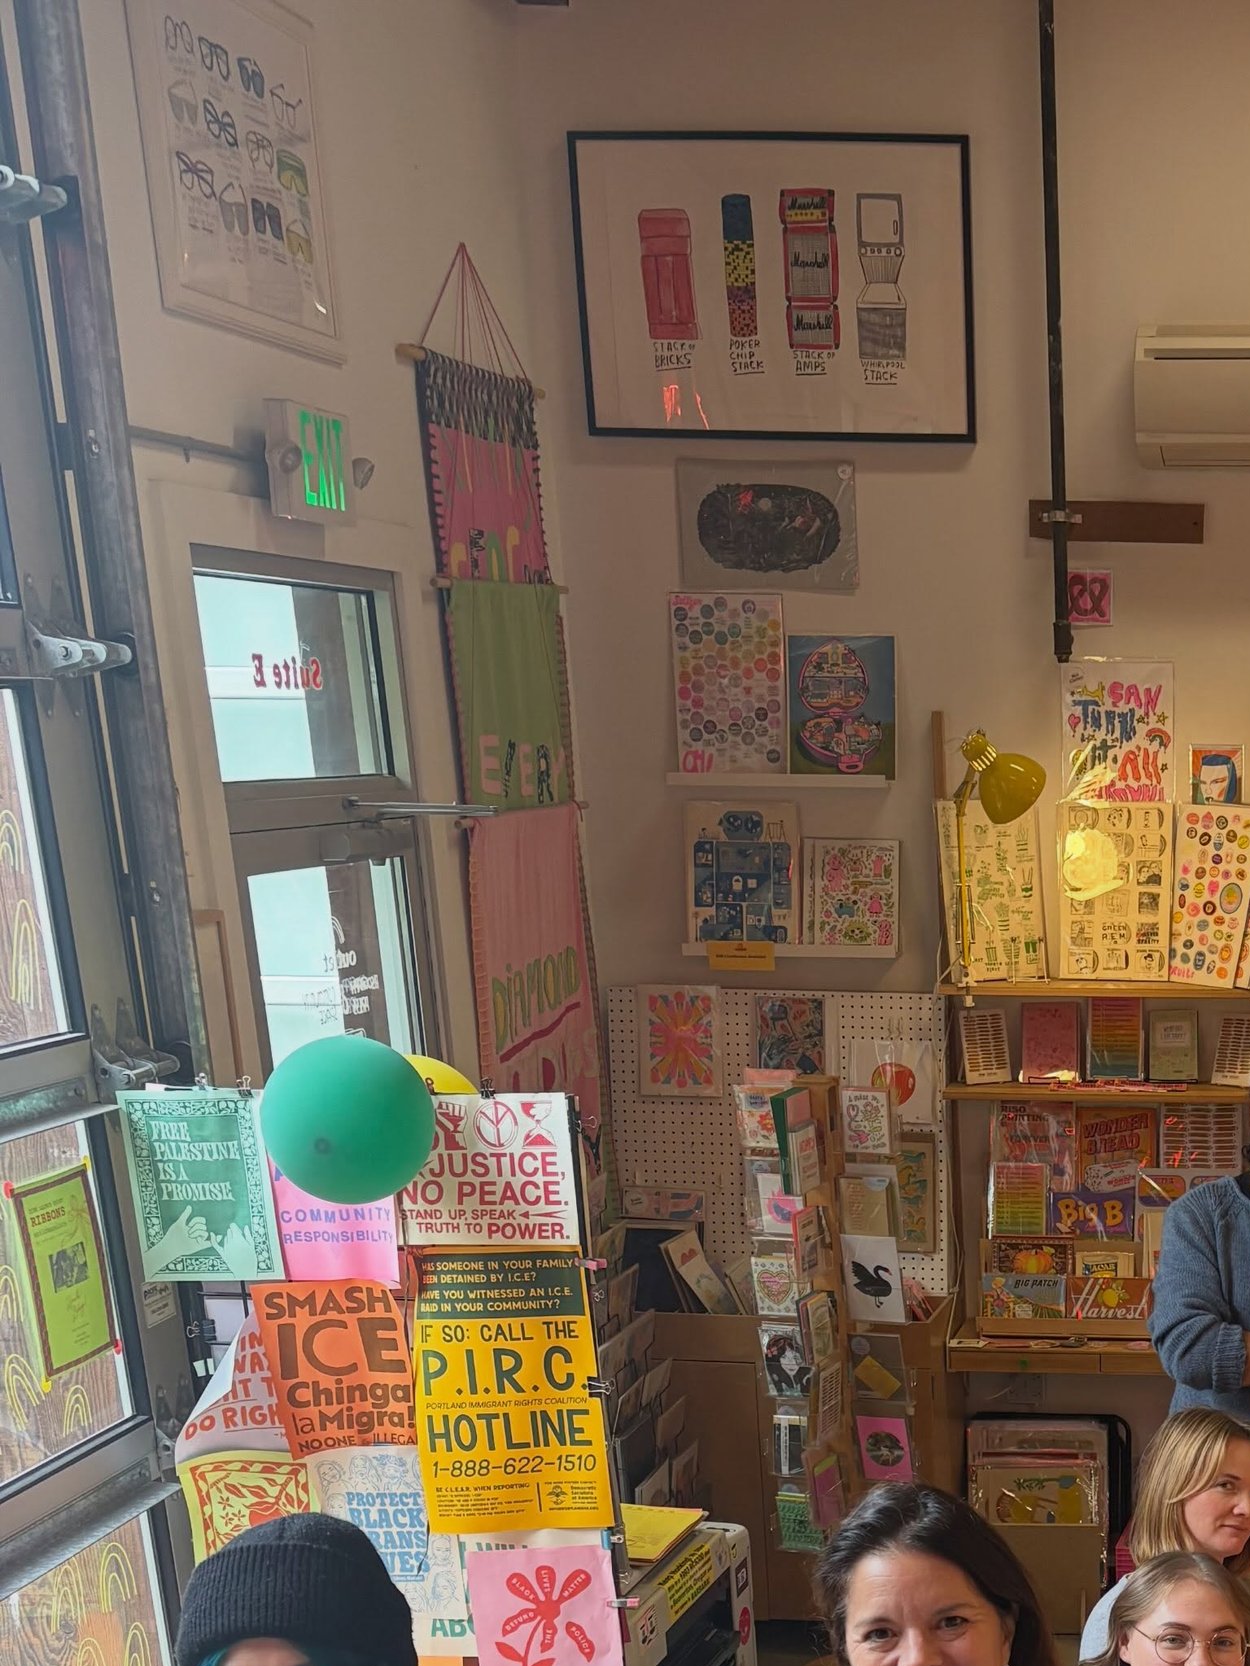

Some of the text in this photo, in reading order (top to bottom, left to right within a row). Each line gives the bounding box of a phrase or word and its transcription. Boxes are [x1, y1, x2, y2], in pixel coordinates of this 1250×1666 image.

[729, 339, 760, 350] POKER
[793, 350, 824, 360] STACK
[655, 353, 692, 367] BRICKS
[729, 351, 755, 361] CHIP
[730, 360, 764, 371] STACK
[795, 360, 826, 372] AMPS
[864, 370, 898, 382] STACK
[299, 410, 347, 512] EXIT
[149, 1120, 191, 1142] FREE
[1082, 1112, 1149, 1139] WONDER
[153, 1140, 241, 1161] PALESTINE
[1087, 1134, 1141, 1156] BREAD
[157, 1163, 189, 1181] IS A
[428, 1151, 566, 1180] JUSTICE,
[160, 1181, 235, 1201] PROMISE
[396, 1180, 569, 1206] NO PEACE.
[30, 1206, 66, 1228] RIBBONS
[280, 1206, 391, 1224] COMMUNITY
[400, 1209, 517, 1221] STAND UP, SPEAK
[1104, 1200, 1125, 1227] B
[283, 1230, 394, 1245] RESPONSIBILITY
[416, 1222, 571, 1240] TRUTH TO POWER.
[421, 1259, 574, 1271] HAS SOMEONE IN YOUR FAMILY
[422, 1274, 438, 1284] BEEN
[440, 1273, 487, 1284] DETAINED
[490, 1273, 504, 1283] BY
[1014, 1279, 1060, 1289] BIG PATCH
[264, 1286, 392, 1321] SMASH
[421, 1286, 574, 1300] HAVE YOU WITNESSED AN I.C.E.
[1070, 1277, 1151, 1320] Harvest
[420, 1299, 561, 1313] RAID IN YOUR COMMUNITY?
[421, 1320, 579, 1343] IF SO: CALL THE
[277, 1317, 408, 1381] ICE
[422, 1346, 588, 1396] P.I.R.C.
[286, 1377, 411, 1410] Chinga
[426, 1397, 588, 1410] PORTLAND IMMIGRANT RIGHTS COALITION
[185, 1415, 216, 1441] DO
[292, 1406, 417, 1437] la Migra!
[427, 1409, 593, 1453] HOTLINE
[298, 1433, 418, 1453] NO ONE ILLEGA
[432, 1453, 597, 1478] 1-888-622-1510
[493, 1483, 530, 1491] REPORTING
[345, 1492, 421, 1508] PROTECT
[350, 1508, 425, 1529] BLACK
[374, 1531, 427, 1550] RANS
[383, 1551, 430, 1574] VES
[511, 1577, 535, 1600] BLACK
[563, 1573, 588, 1598] MATTER
[506, 1611, 535, 1632] DEFUND
[545, 1628, 553, 1644] THE
[570, 1626, 591, 1654] POLICE
